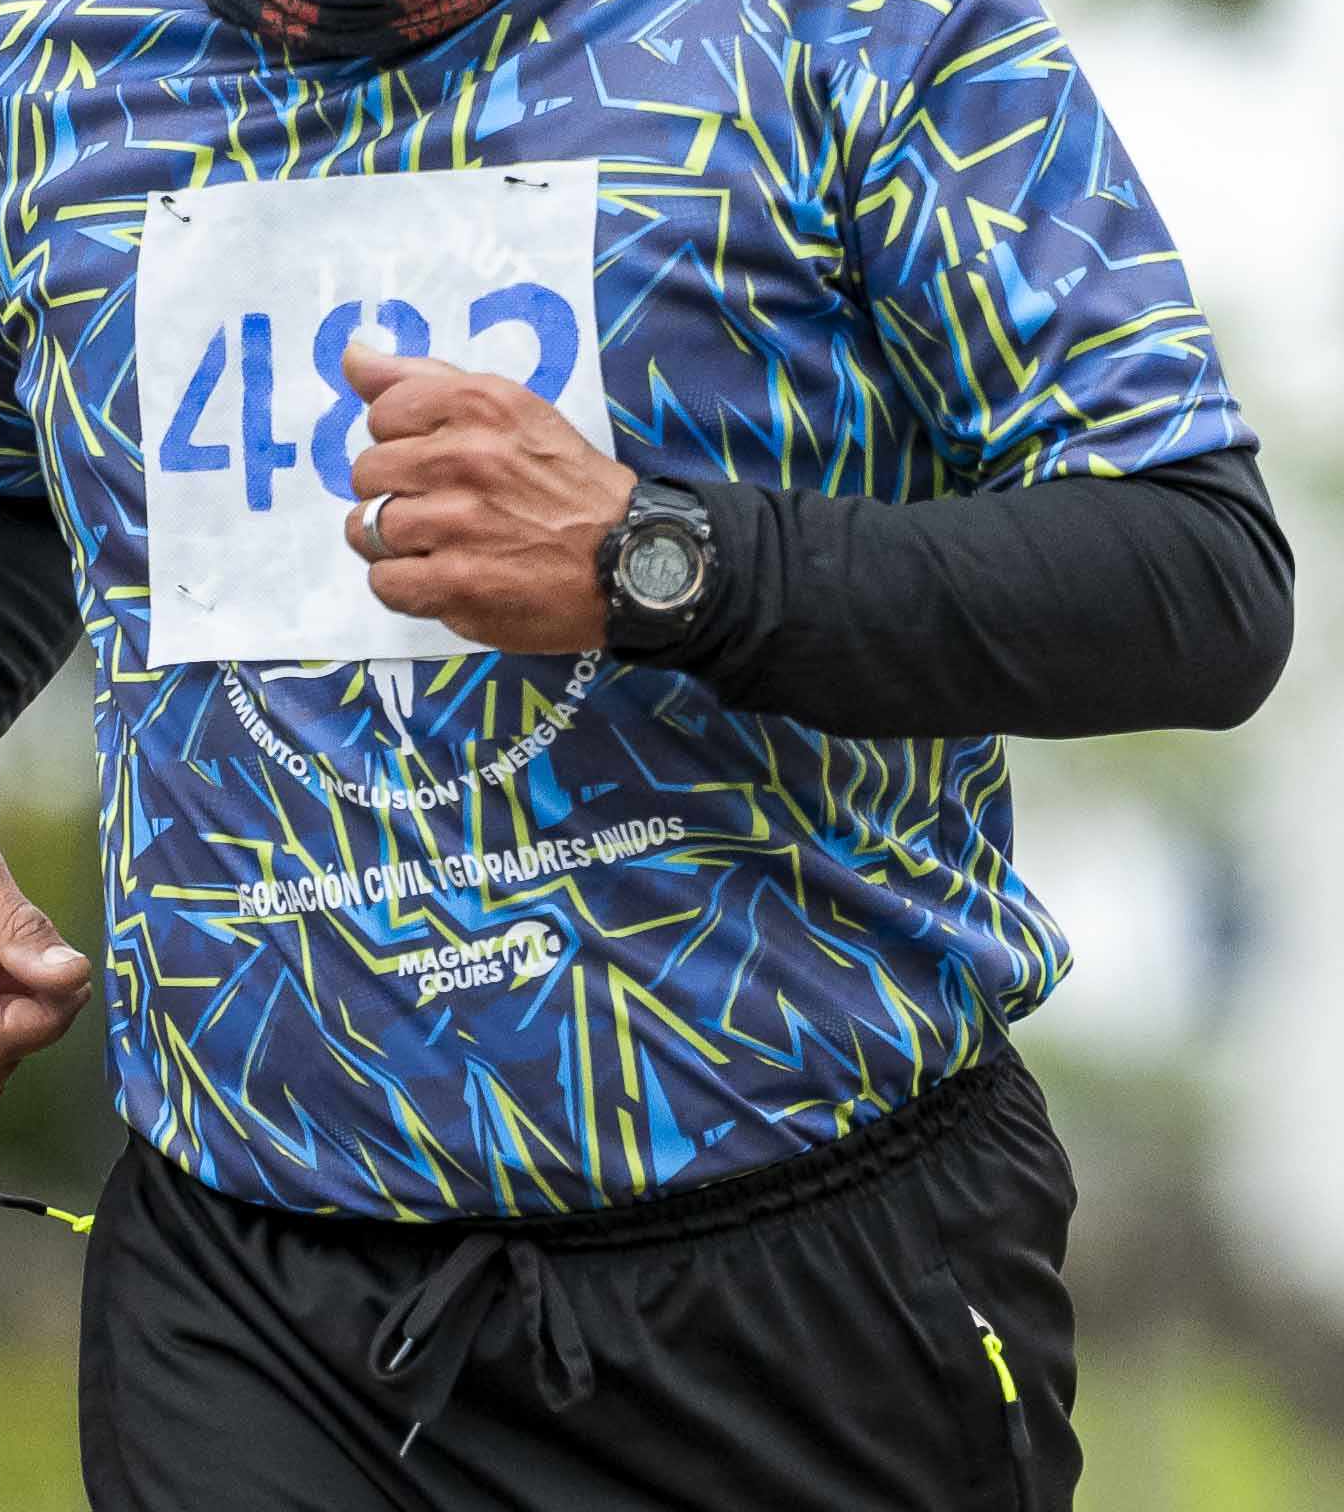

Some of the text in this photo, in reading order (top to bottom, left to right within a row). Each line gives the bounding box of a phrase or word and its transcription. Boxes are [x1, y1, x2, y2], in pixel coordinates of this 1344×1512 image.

[217, 659, 312, 786] VIMIENTO,
[319, 771, 461, 811] INCLUSIÓN
[458, 767, 481, 793] Y
[363, 858, 433, 904] CIVIL
[429, 853, 484, 891] TGD
[482, 837, 593, 885] PADRES
[590, 816, 686, 865] UNIDOS
[397, 937, 498, 977] MAGNY
[418, 960, 505, 996] COURS
